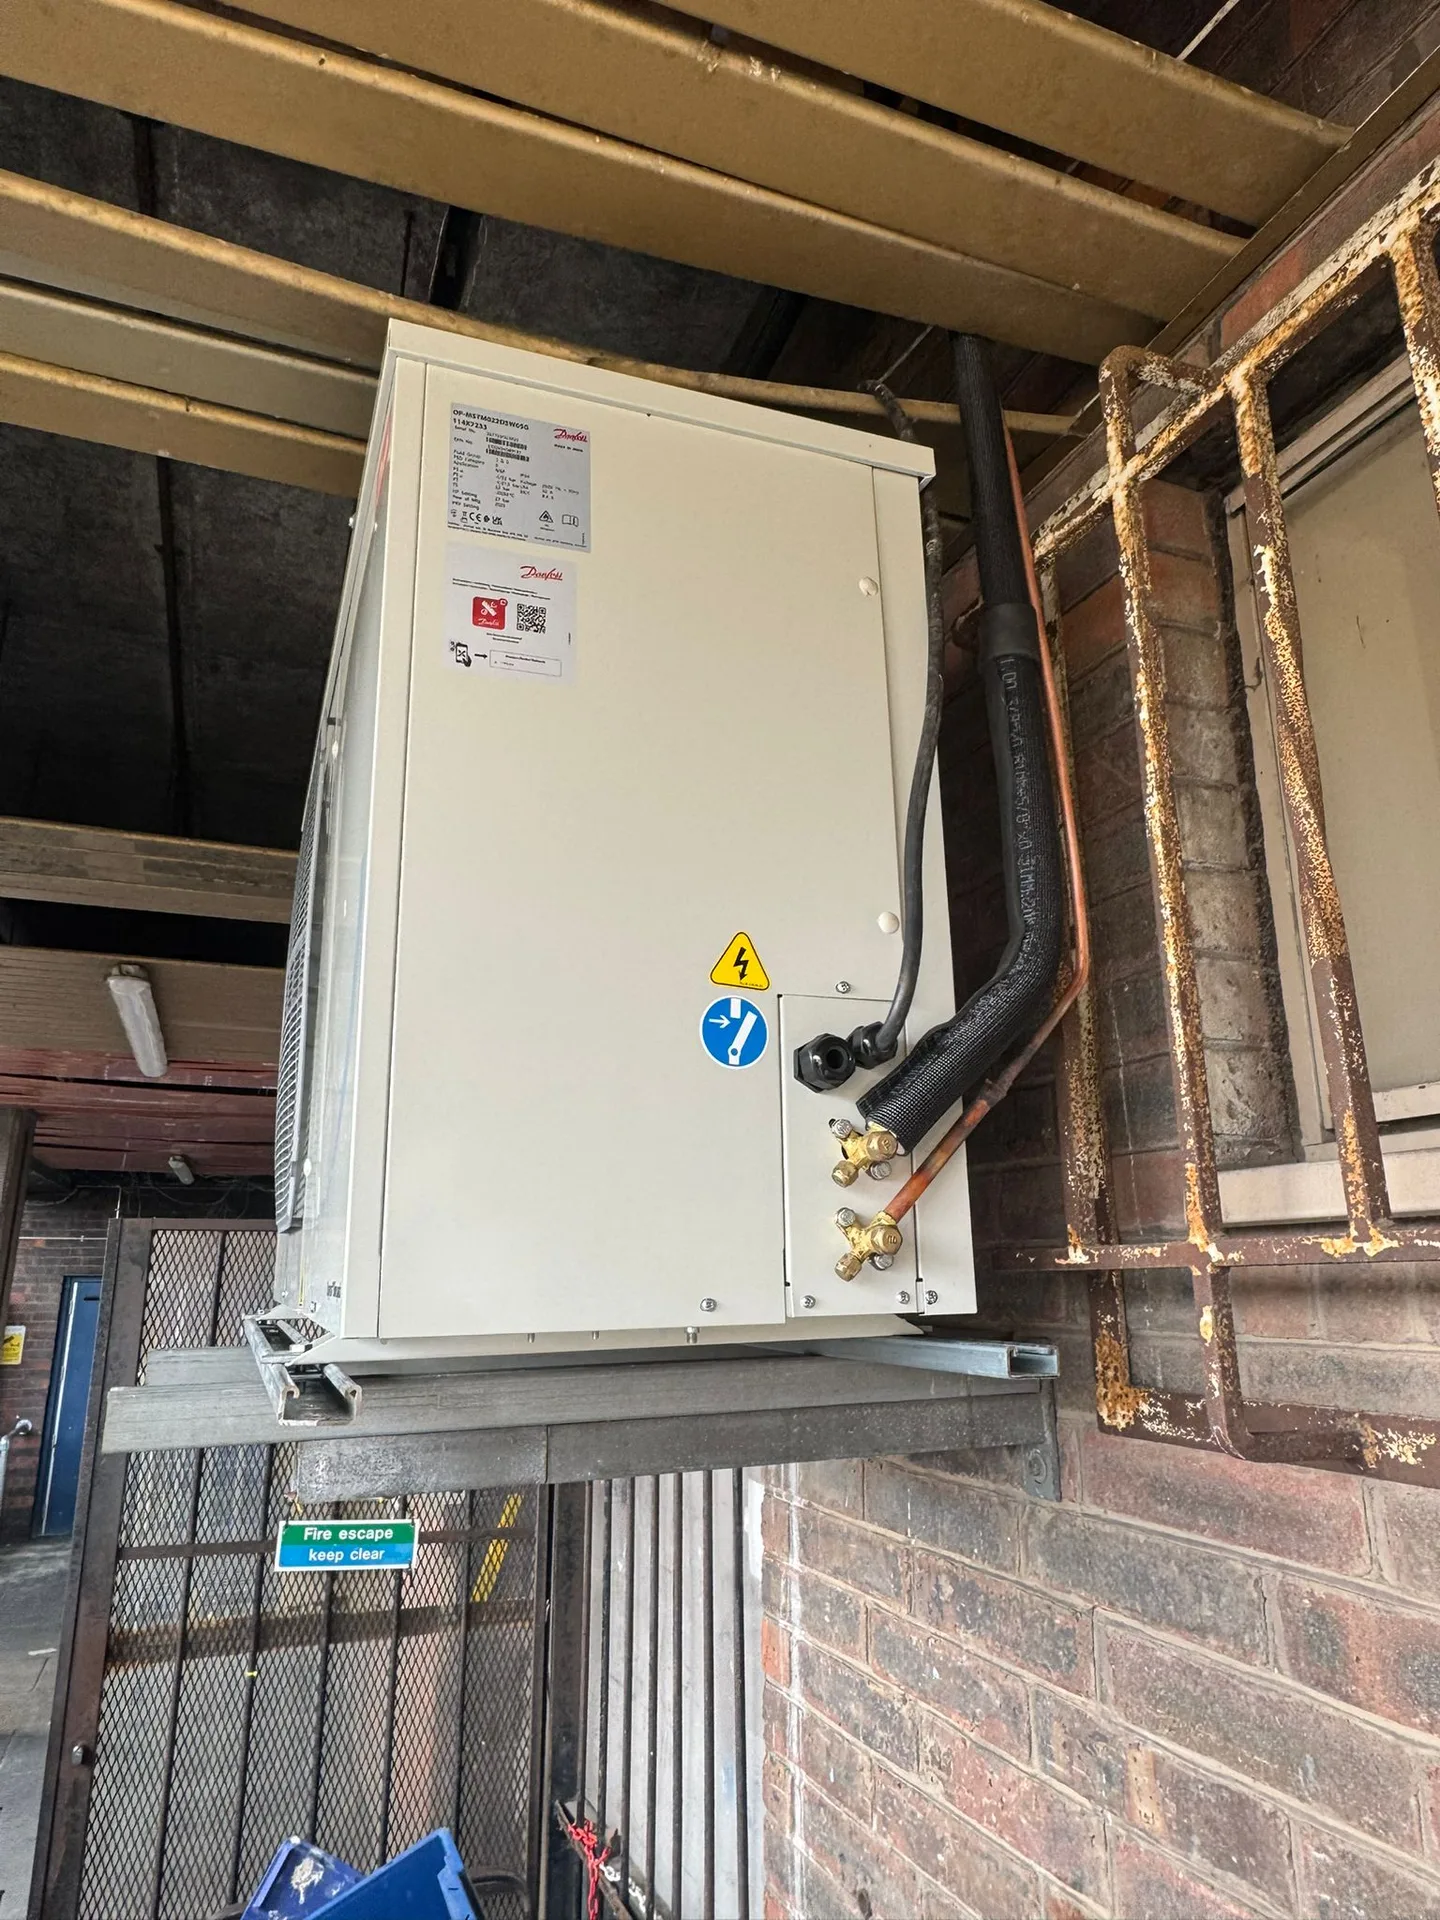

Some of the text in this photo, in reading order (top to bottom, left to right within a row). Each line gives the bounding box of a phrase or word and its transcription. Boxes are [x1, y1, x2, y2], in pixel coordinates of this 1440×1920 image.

[520, 565, 563, 582] Danfoss
[303, 1527, 394, 1542] Fire escape
[308, 1548, 385, 1563] keep clear
